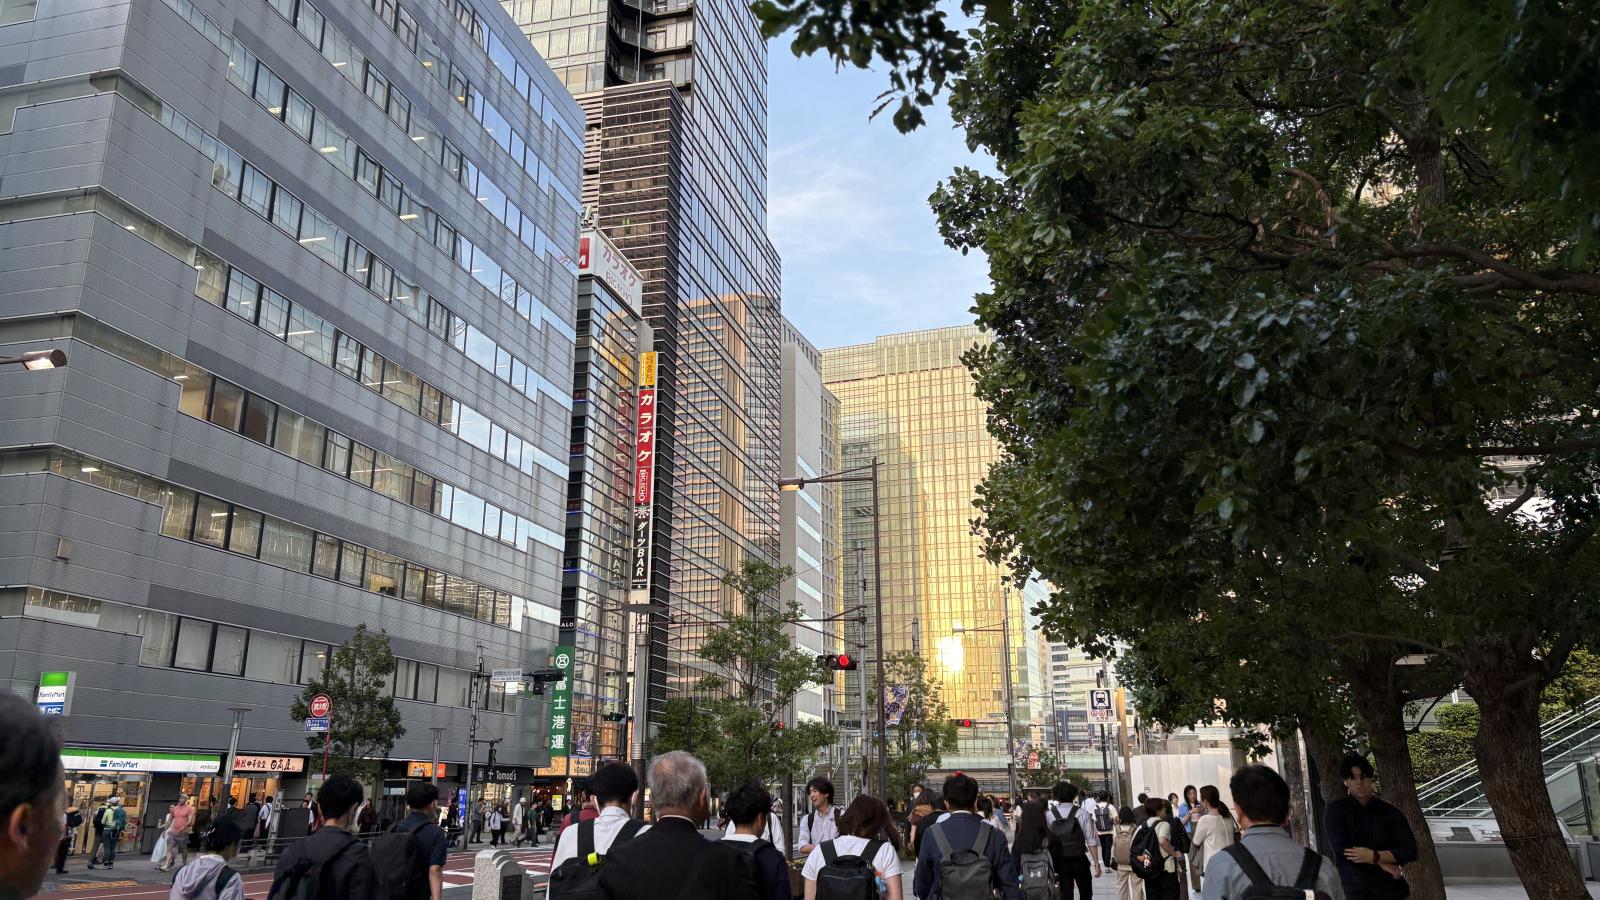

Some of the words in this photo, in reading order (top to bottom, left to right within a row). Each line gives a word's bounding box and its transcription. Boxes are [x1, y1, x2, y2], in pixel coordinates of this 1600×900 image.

[638, 393, 654, 462] カラオケ
[638, 483, 646, 502] ECHO
[39, 691, 65, 699] FamilyMart
[108, 760, 138, 769] FamilyMart
[496, 769, 517, 781] Tomod's
